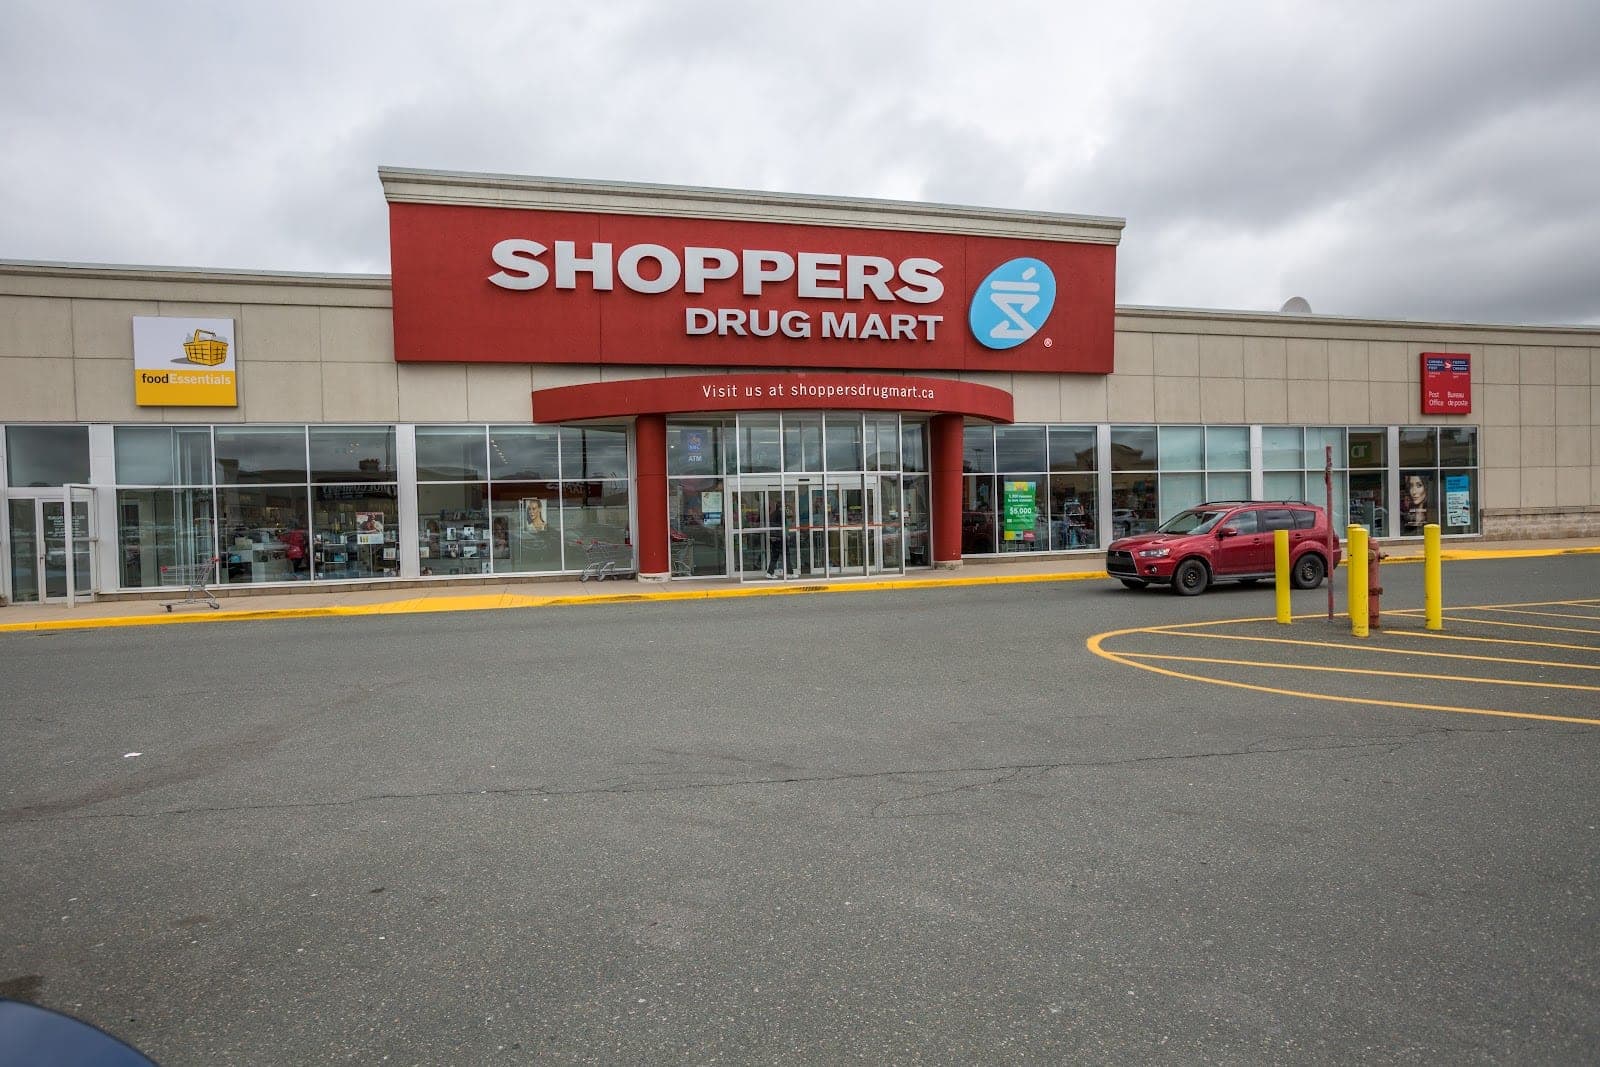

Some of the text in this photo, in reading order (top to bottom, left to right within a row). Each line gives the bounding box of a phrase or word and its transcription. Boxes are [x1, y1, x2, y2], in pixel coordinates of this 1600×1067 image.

[488, 238, 945, 304] SHOPPERS
[685, 307, 944, 341] DRUG MART
[702, 383, 935, 399] Visit us at shoppersdrugmart.ca
